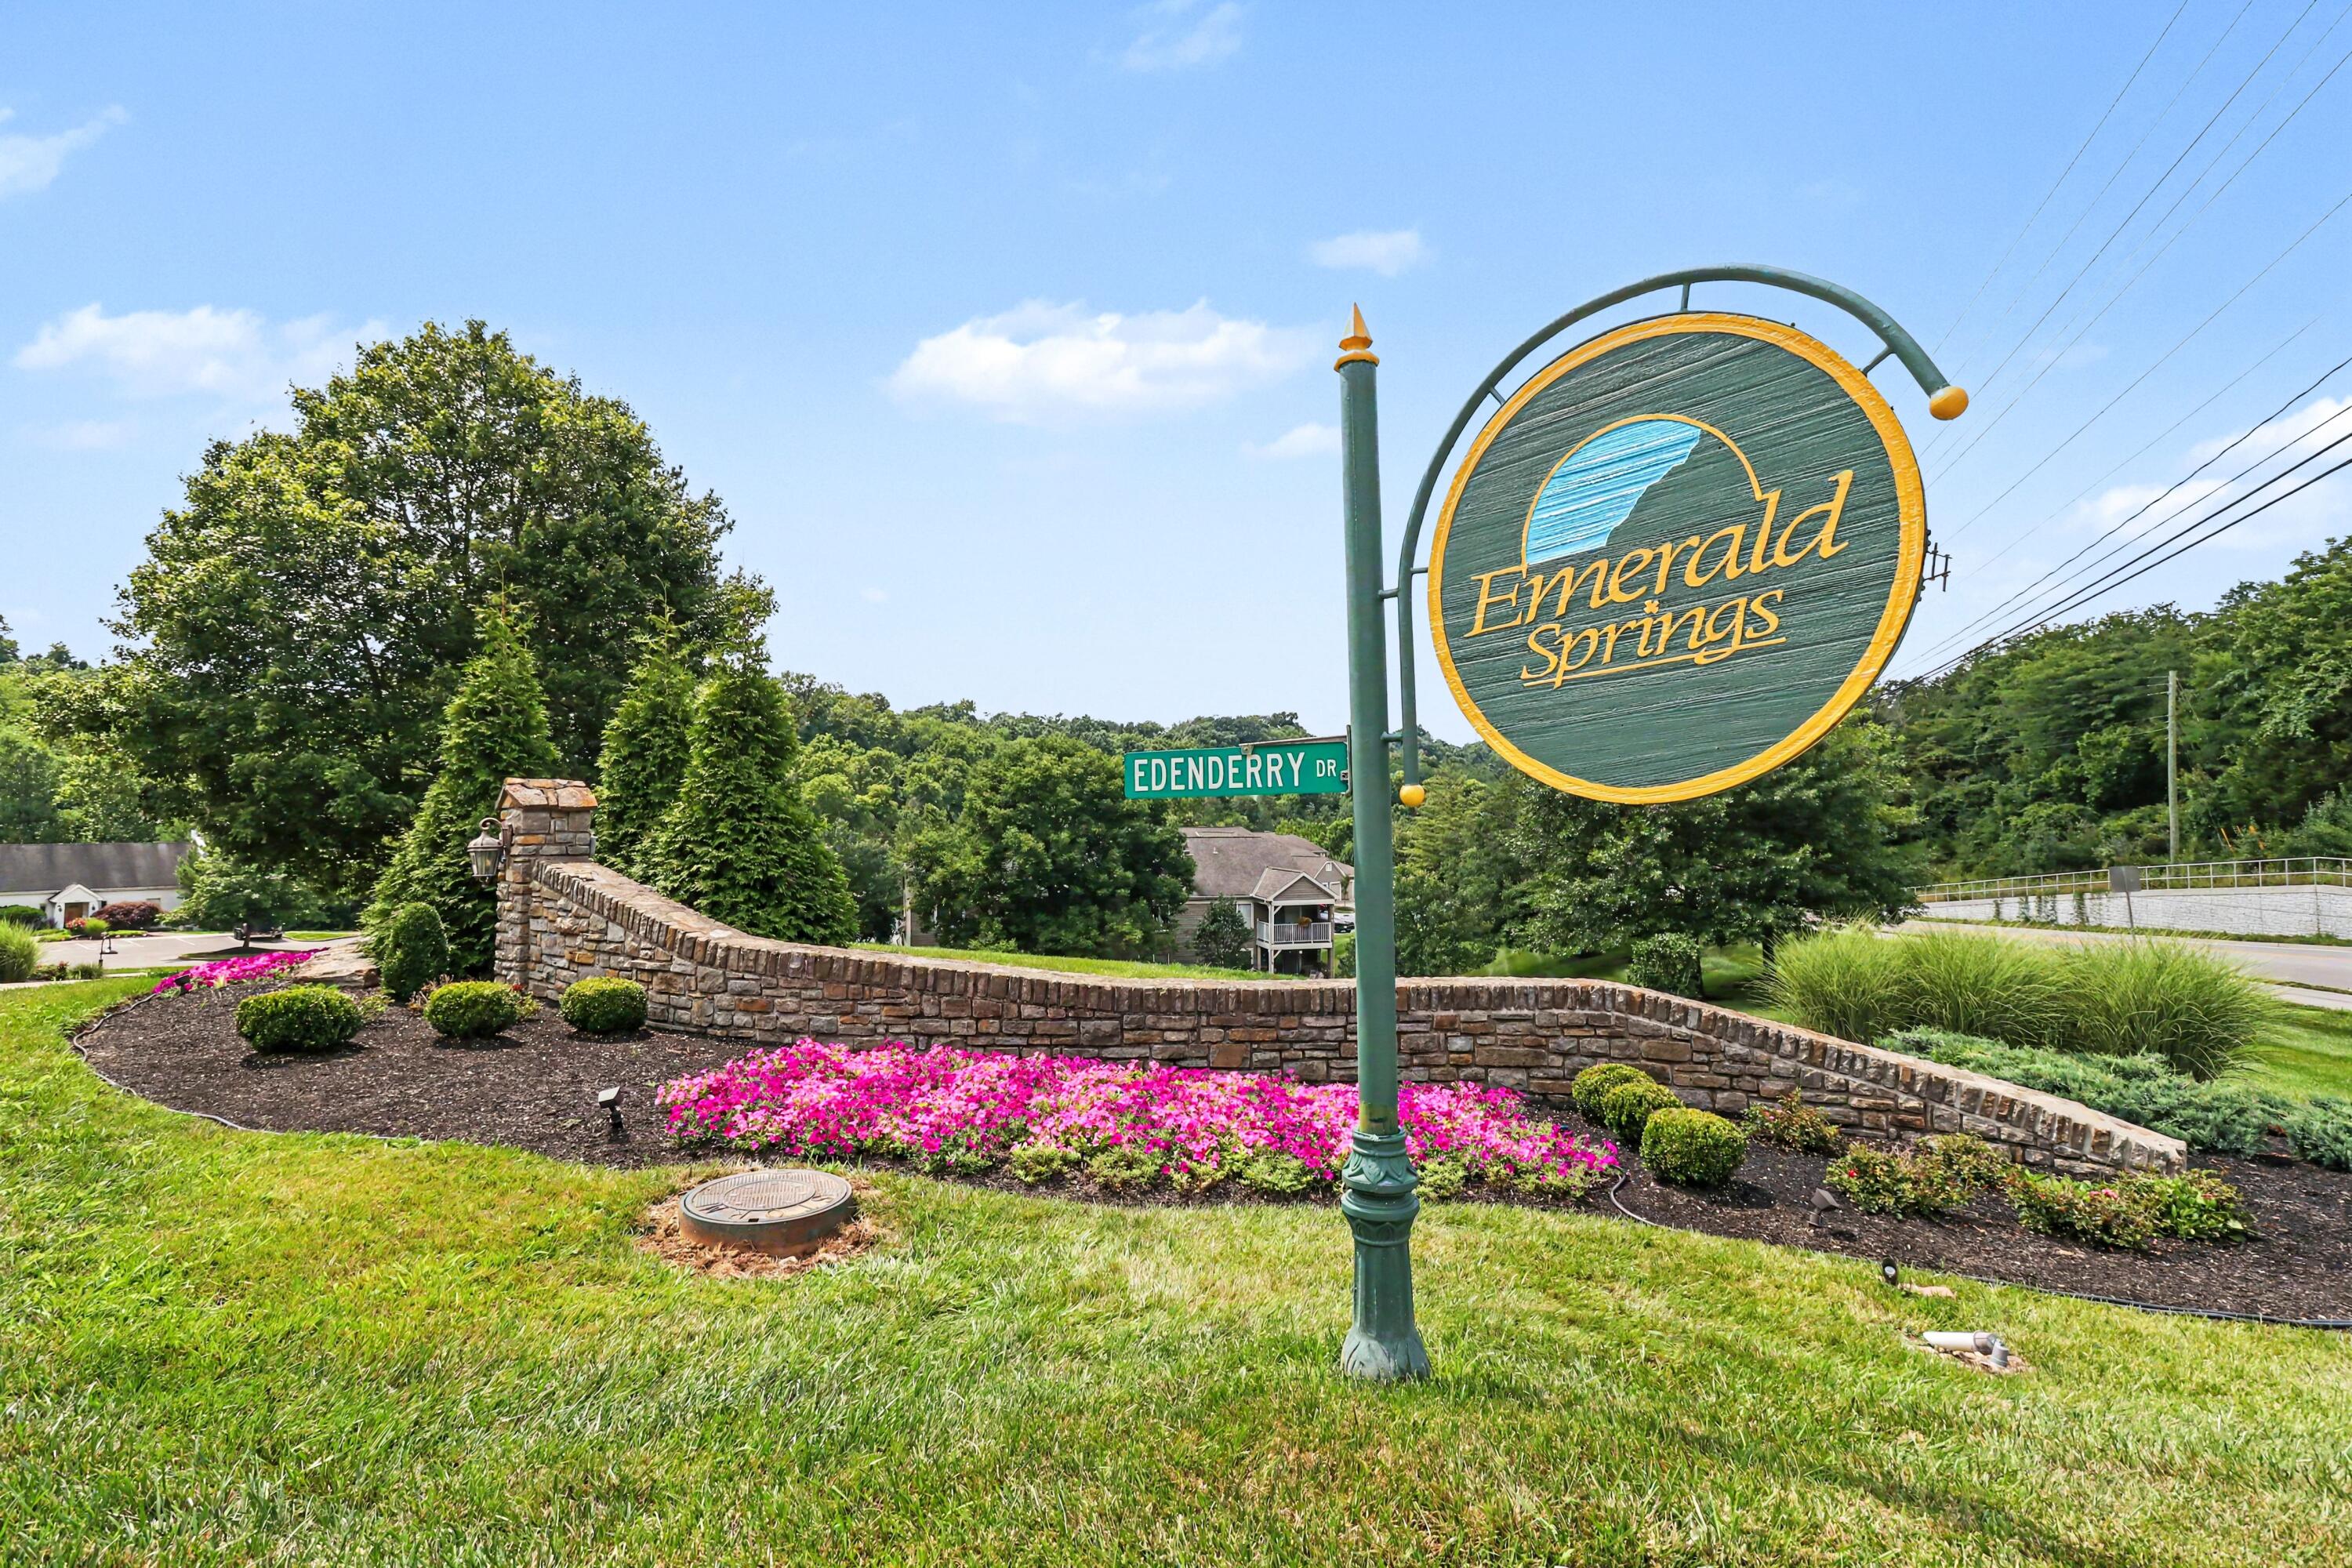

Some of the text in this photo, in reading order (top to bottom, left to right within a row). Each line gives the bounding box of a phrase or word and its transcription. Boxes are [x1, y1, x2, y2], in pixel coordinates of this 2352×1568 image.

[1463, 469, 1853, 638] Emerald
[1520, 589, 1784, 689] Springs
[1134, 751, 1337, 793] EDENDERRY DR
